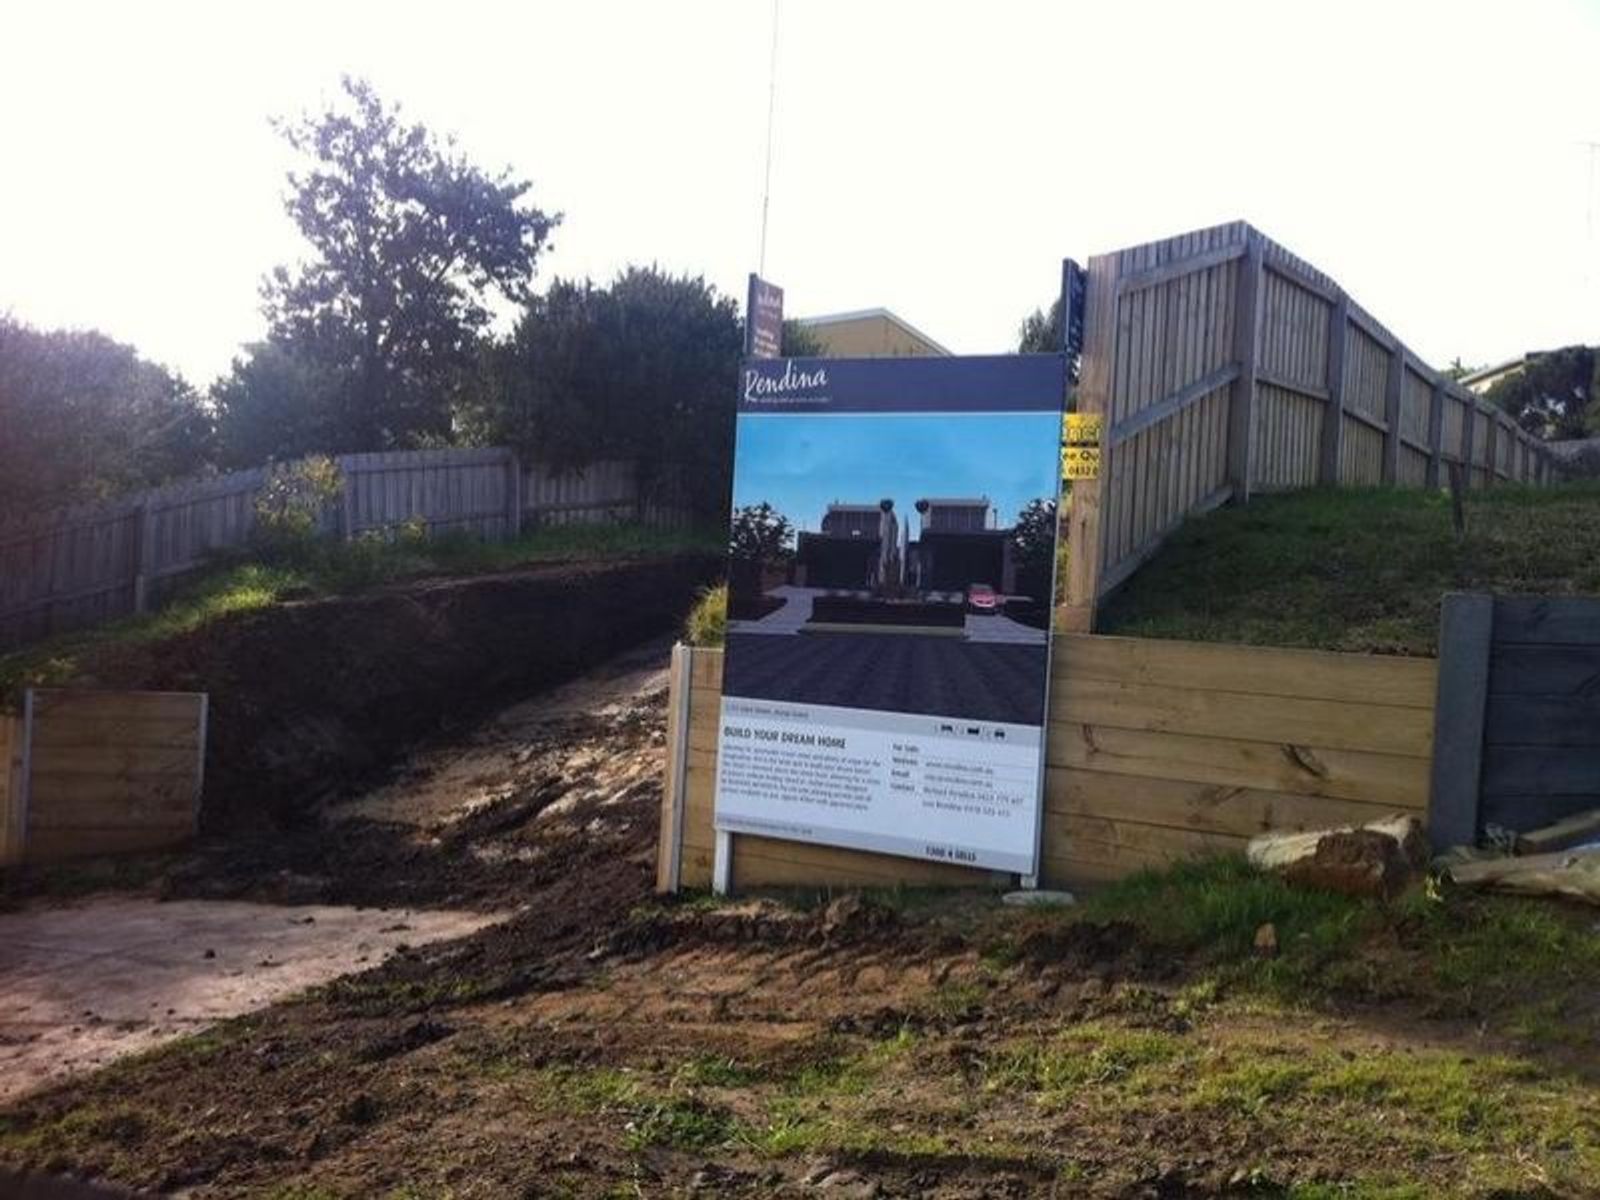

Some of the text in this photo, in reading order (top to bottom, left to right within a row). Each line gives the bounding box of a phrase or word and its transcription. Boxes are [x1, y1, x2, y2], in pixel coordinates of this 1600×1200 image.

[744, 359, 828, 403] Rendina
[724, 726, 846, 749] BUILD YOUR DREAM HOME
